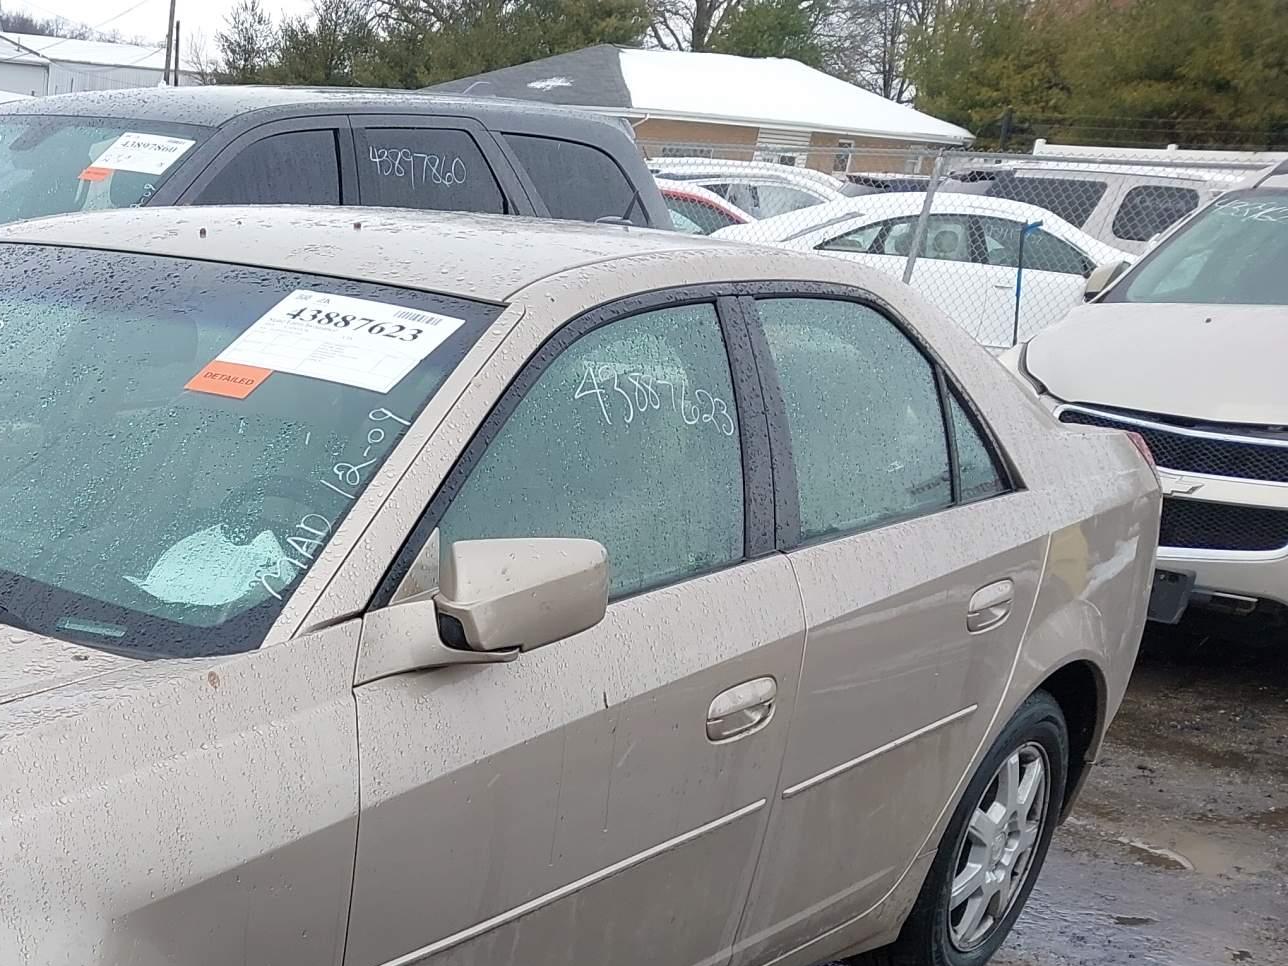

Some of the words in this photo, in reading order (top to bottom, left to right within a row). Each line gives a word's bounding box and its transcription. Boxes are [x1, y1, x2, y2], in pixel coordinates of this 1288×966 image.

[369, 145, 467, 190] 43897860
[286, 306, 424, 342] 43887623
[203, 370, 255, 386] DETAILED
[574, 365, 735, 437] 43887623
